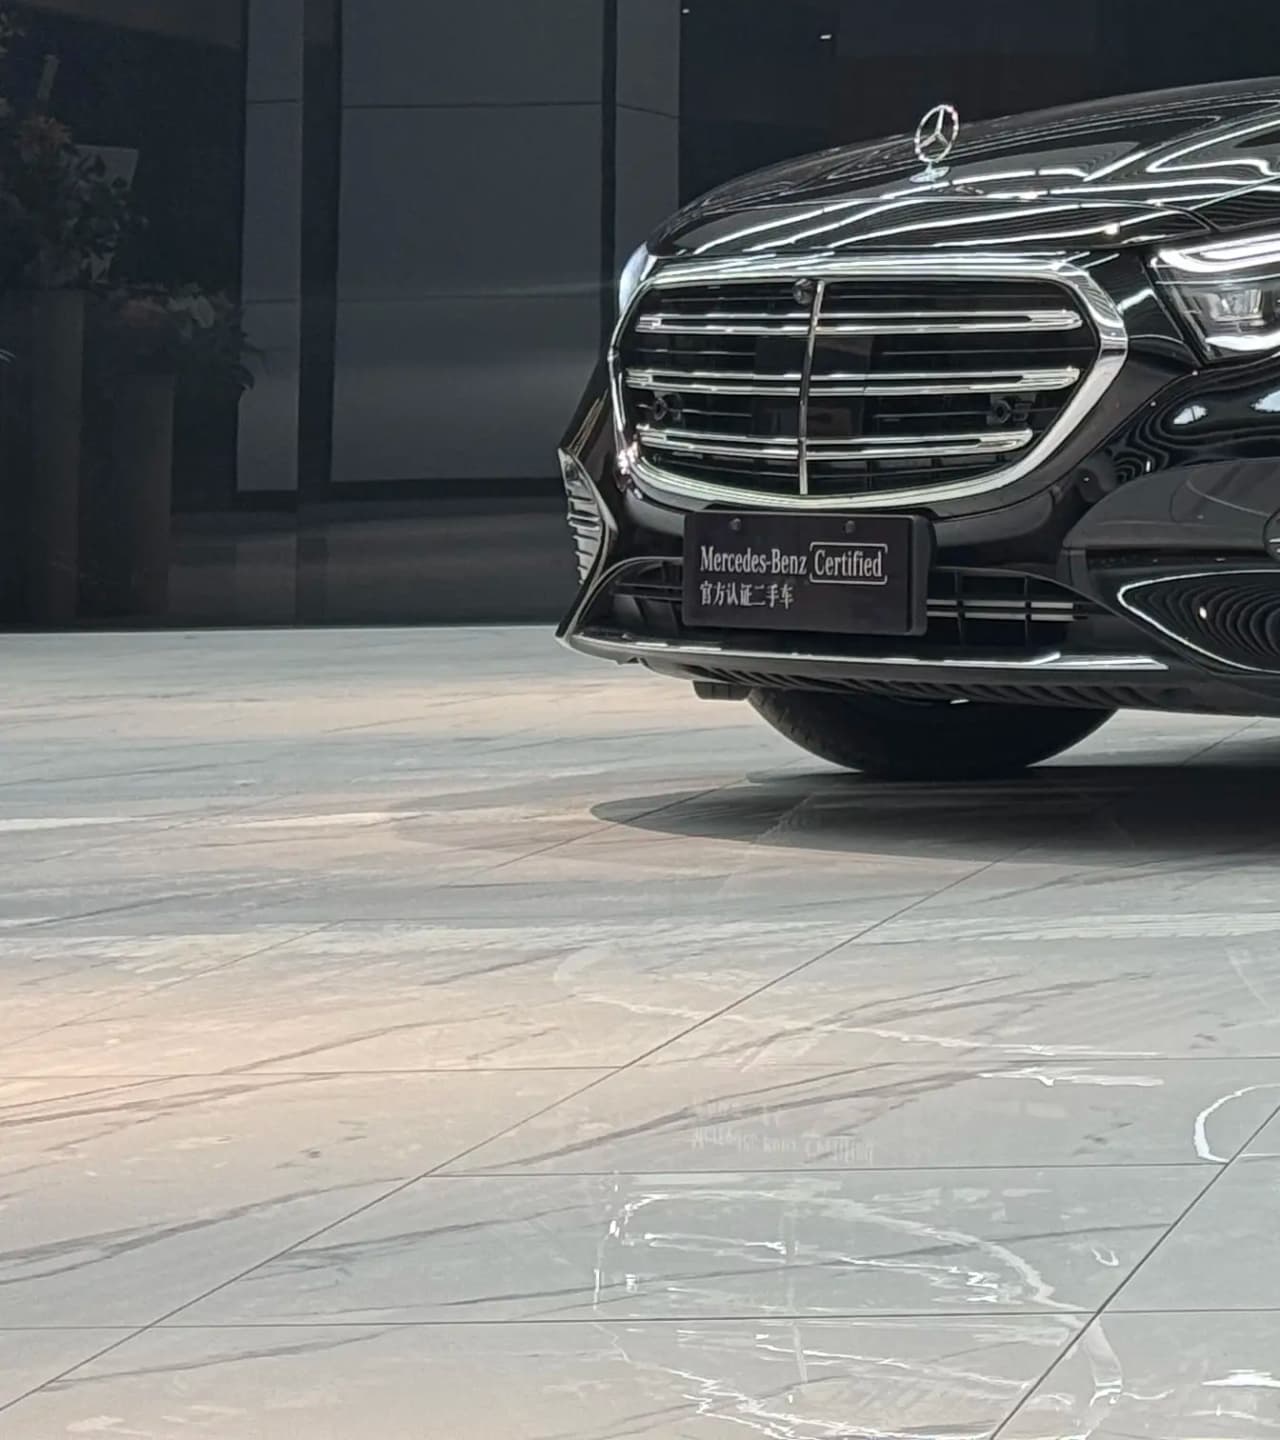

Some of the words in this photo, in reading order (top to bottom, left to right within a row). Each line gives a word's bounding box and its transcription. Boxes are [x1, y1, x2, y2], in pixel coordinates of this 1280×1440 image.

[700, 546, 807, 575] Mercedes-Benz
[814, 550, 882, 577] Certified
[700, 580, 794, 609] 官方认证二手车
